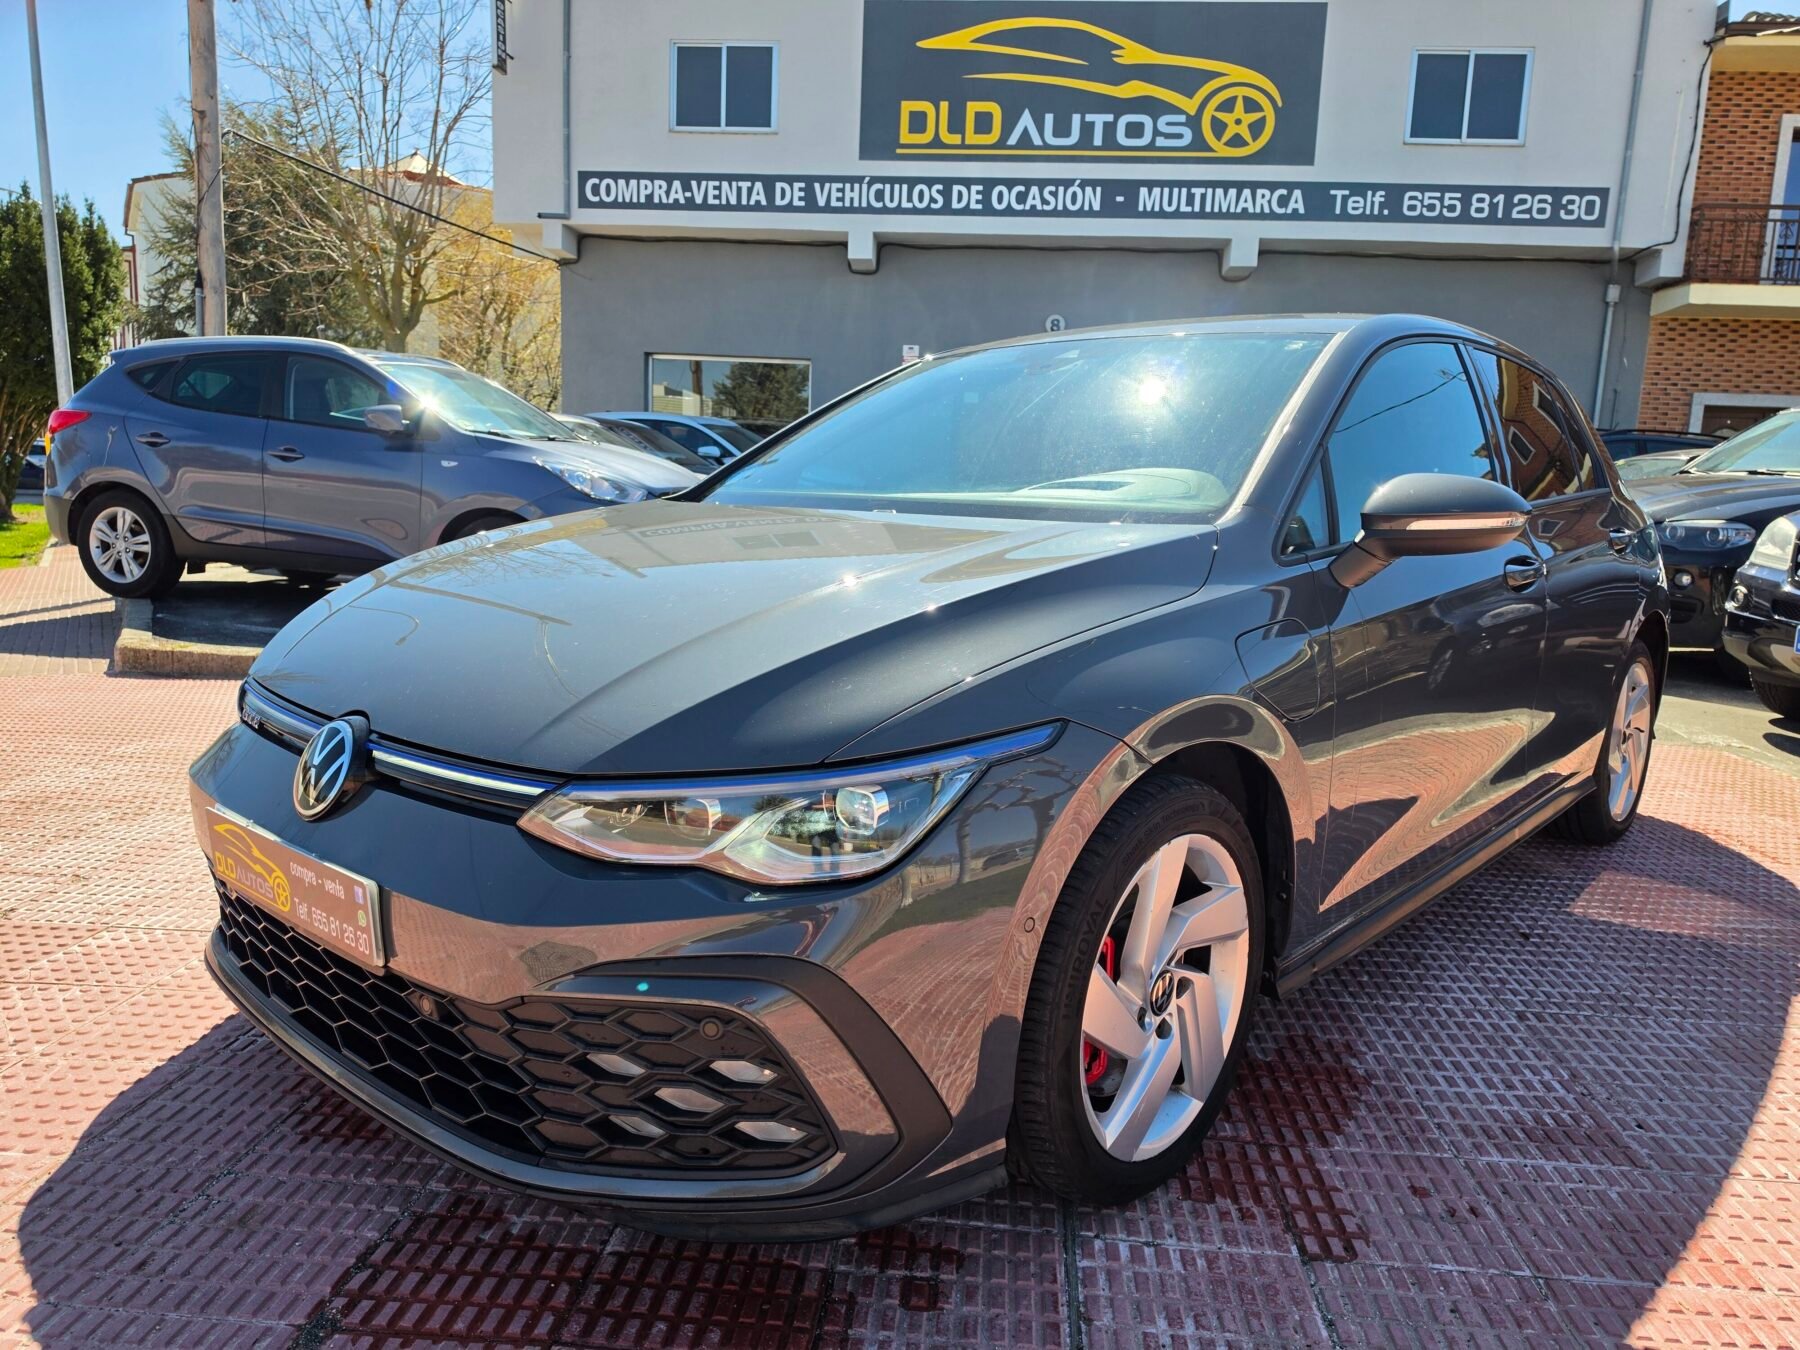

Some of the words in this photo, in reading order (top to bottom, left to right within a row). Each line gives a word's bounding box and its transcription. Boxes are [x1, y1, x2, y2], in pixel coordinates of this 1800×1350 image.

[899, 100, 1002, 145] DLD
[1006, 107, 1193, 147] AUTOS
[584, 177, 767, 206] COMPRA-VENTA
[774, 181, 806, 207] DE
[813, 176, 944, 209] VEHÍCULOS
[951, 184, 984, 210] DE
[991, 179, 1102, 212] OCASIÓN
[1137, 186, 1306, 215] MULTIMARCA
[1329, 189, 1389, 216] Telf.
[1402, 190, 1462, 218] 655
[1469, 192, 1505, 219] 81
[1511, 193, 1553, 220] 26
[1559, 194, 1601, 221] 30
[1049, 317, 1061, 331] 8
[214, 851, 237, 880] DLD
[289, 862, 318, 887] compra
[323, 878, 345, 900] venta
[311, 906, 329, 933] 655
[329, 916, 341, 940] 81
[342, 923, 356, 948] 26
[356, 931, 370, 956] 30
